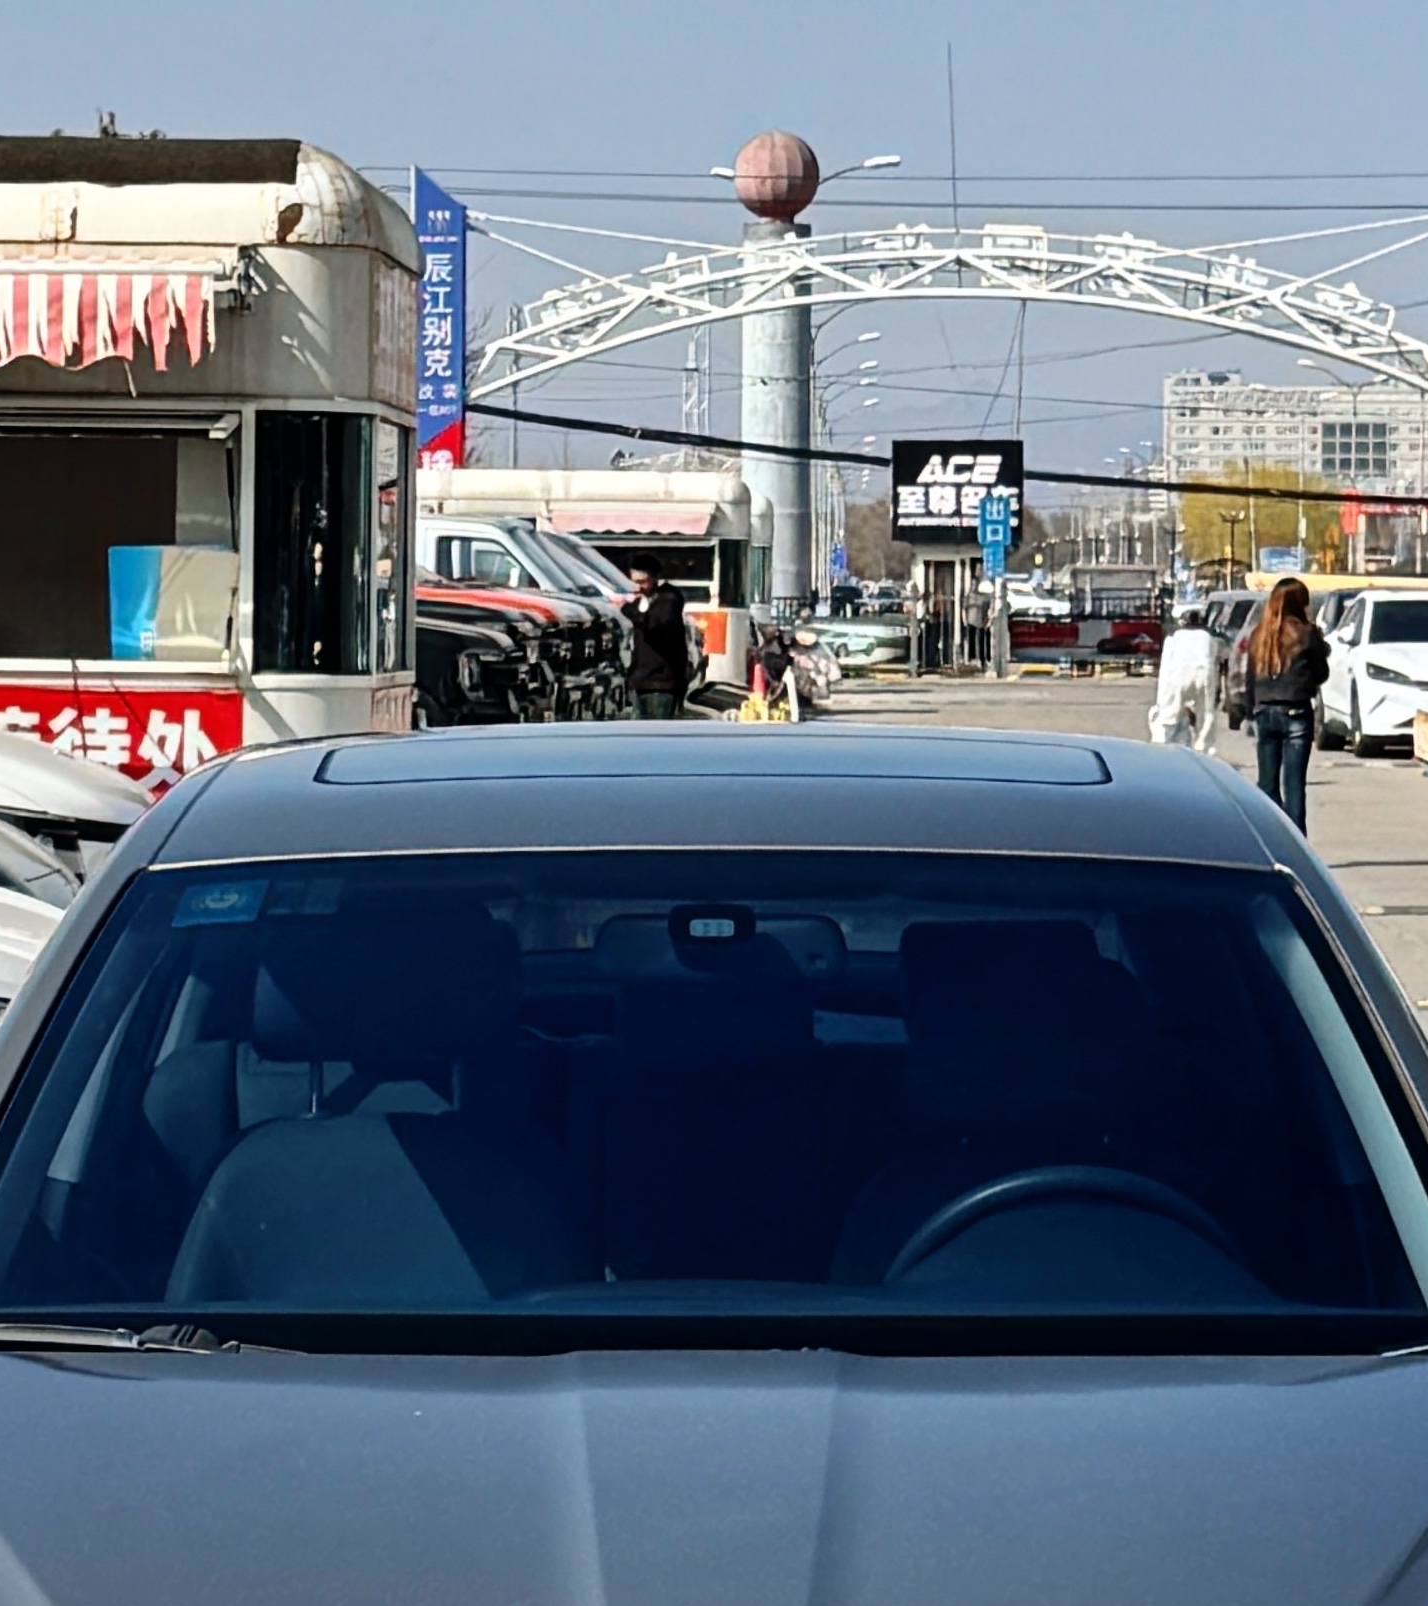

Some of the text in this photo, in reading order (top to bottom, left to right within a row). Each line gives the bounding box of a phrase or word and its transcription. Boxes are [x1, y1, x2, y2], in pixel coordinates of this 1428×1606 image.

[422, 252, 454, 378] 辰江别克
[916, 454, 1003, 484] ACE
[985, 500, 1005, 542] 出口
